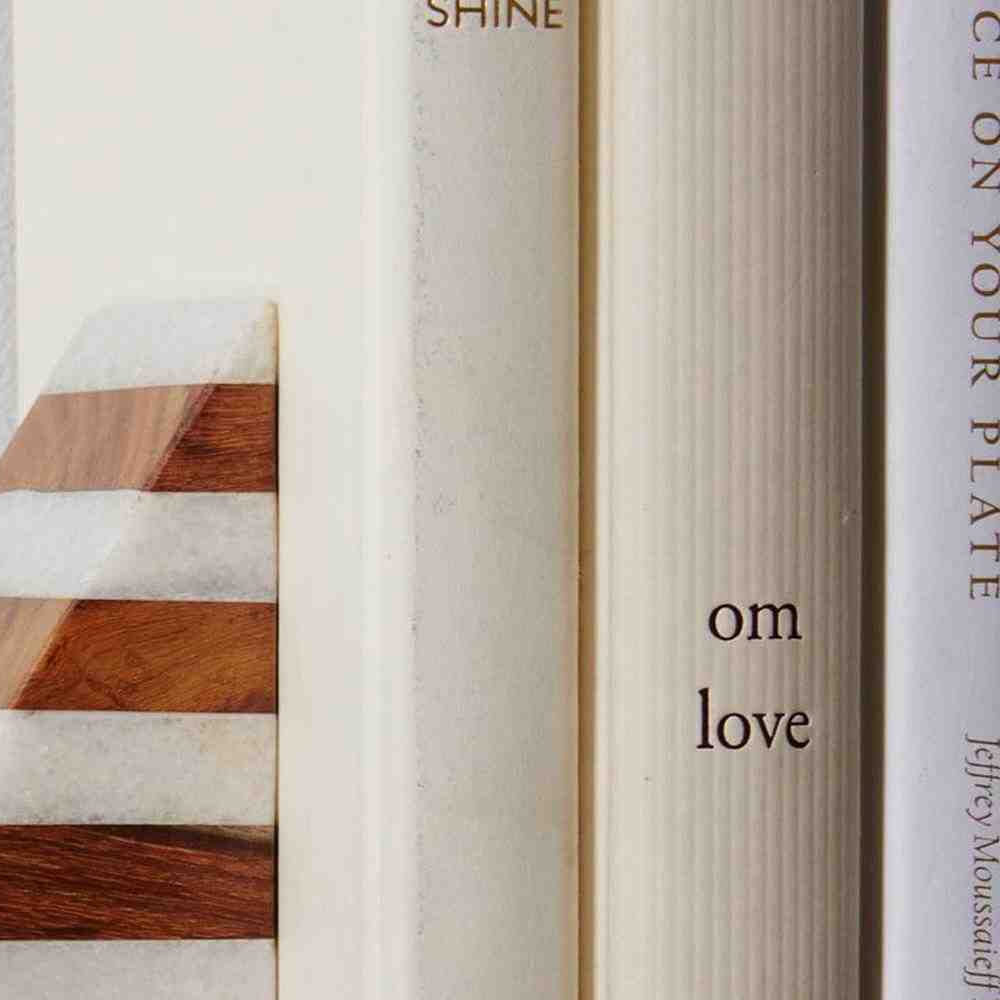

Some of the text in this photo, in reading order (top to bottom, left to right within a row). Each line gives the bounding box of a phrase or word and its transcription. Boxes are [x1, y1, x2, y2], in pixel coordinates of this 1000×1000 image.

[426, 0, 563, 28] SHINE
[970, 10, 1000, 600] CE ON YOUR PLATE
[708, 603, 802, 641] om
[696, 687, 810, 749] love
[965, 732, 1000, 827] Jeffrey
[963, 834, 1000, 993] Moussaieff
